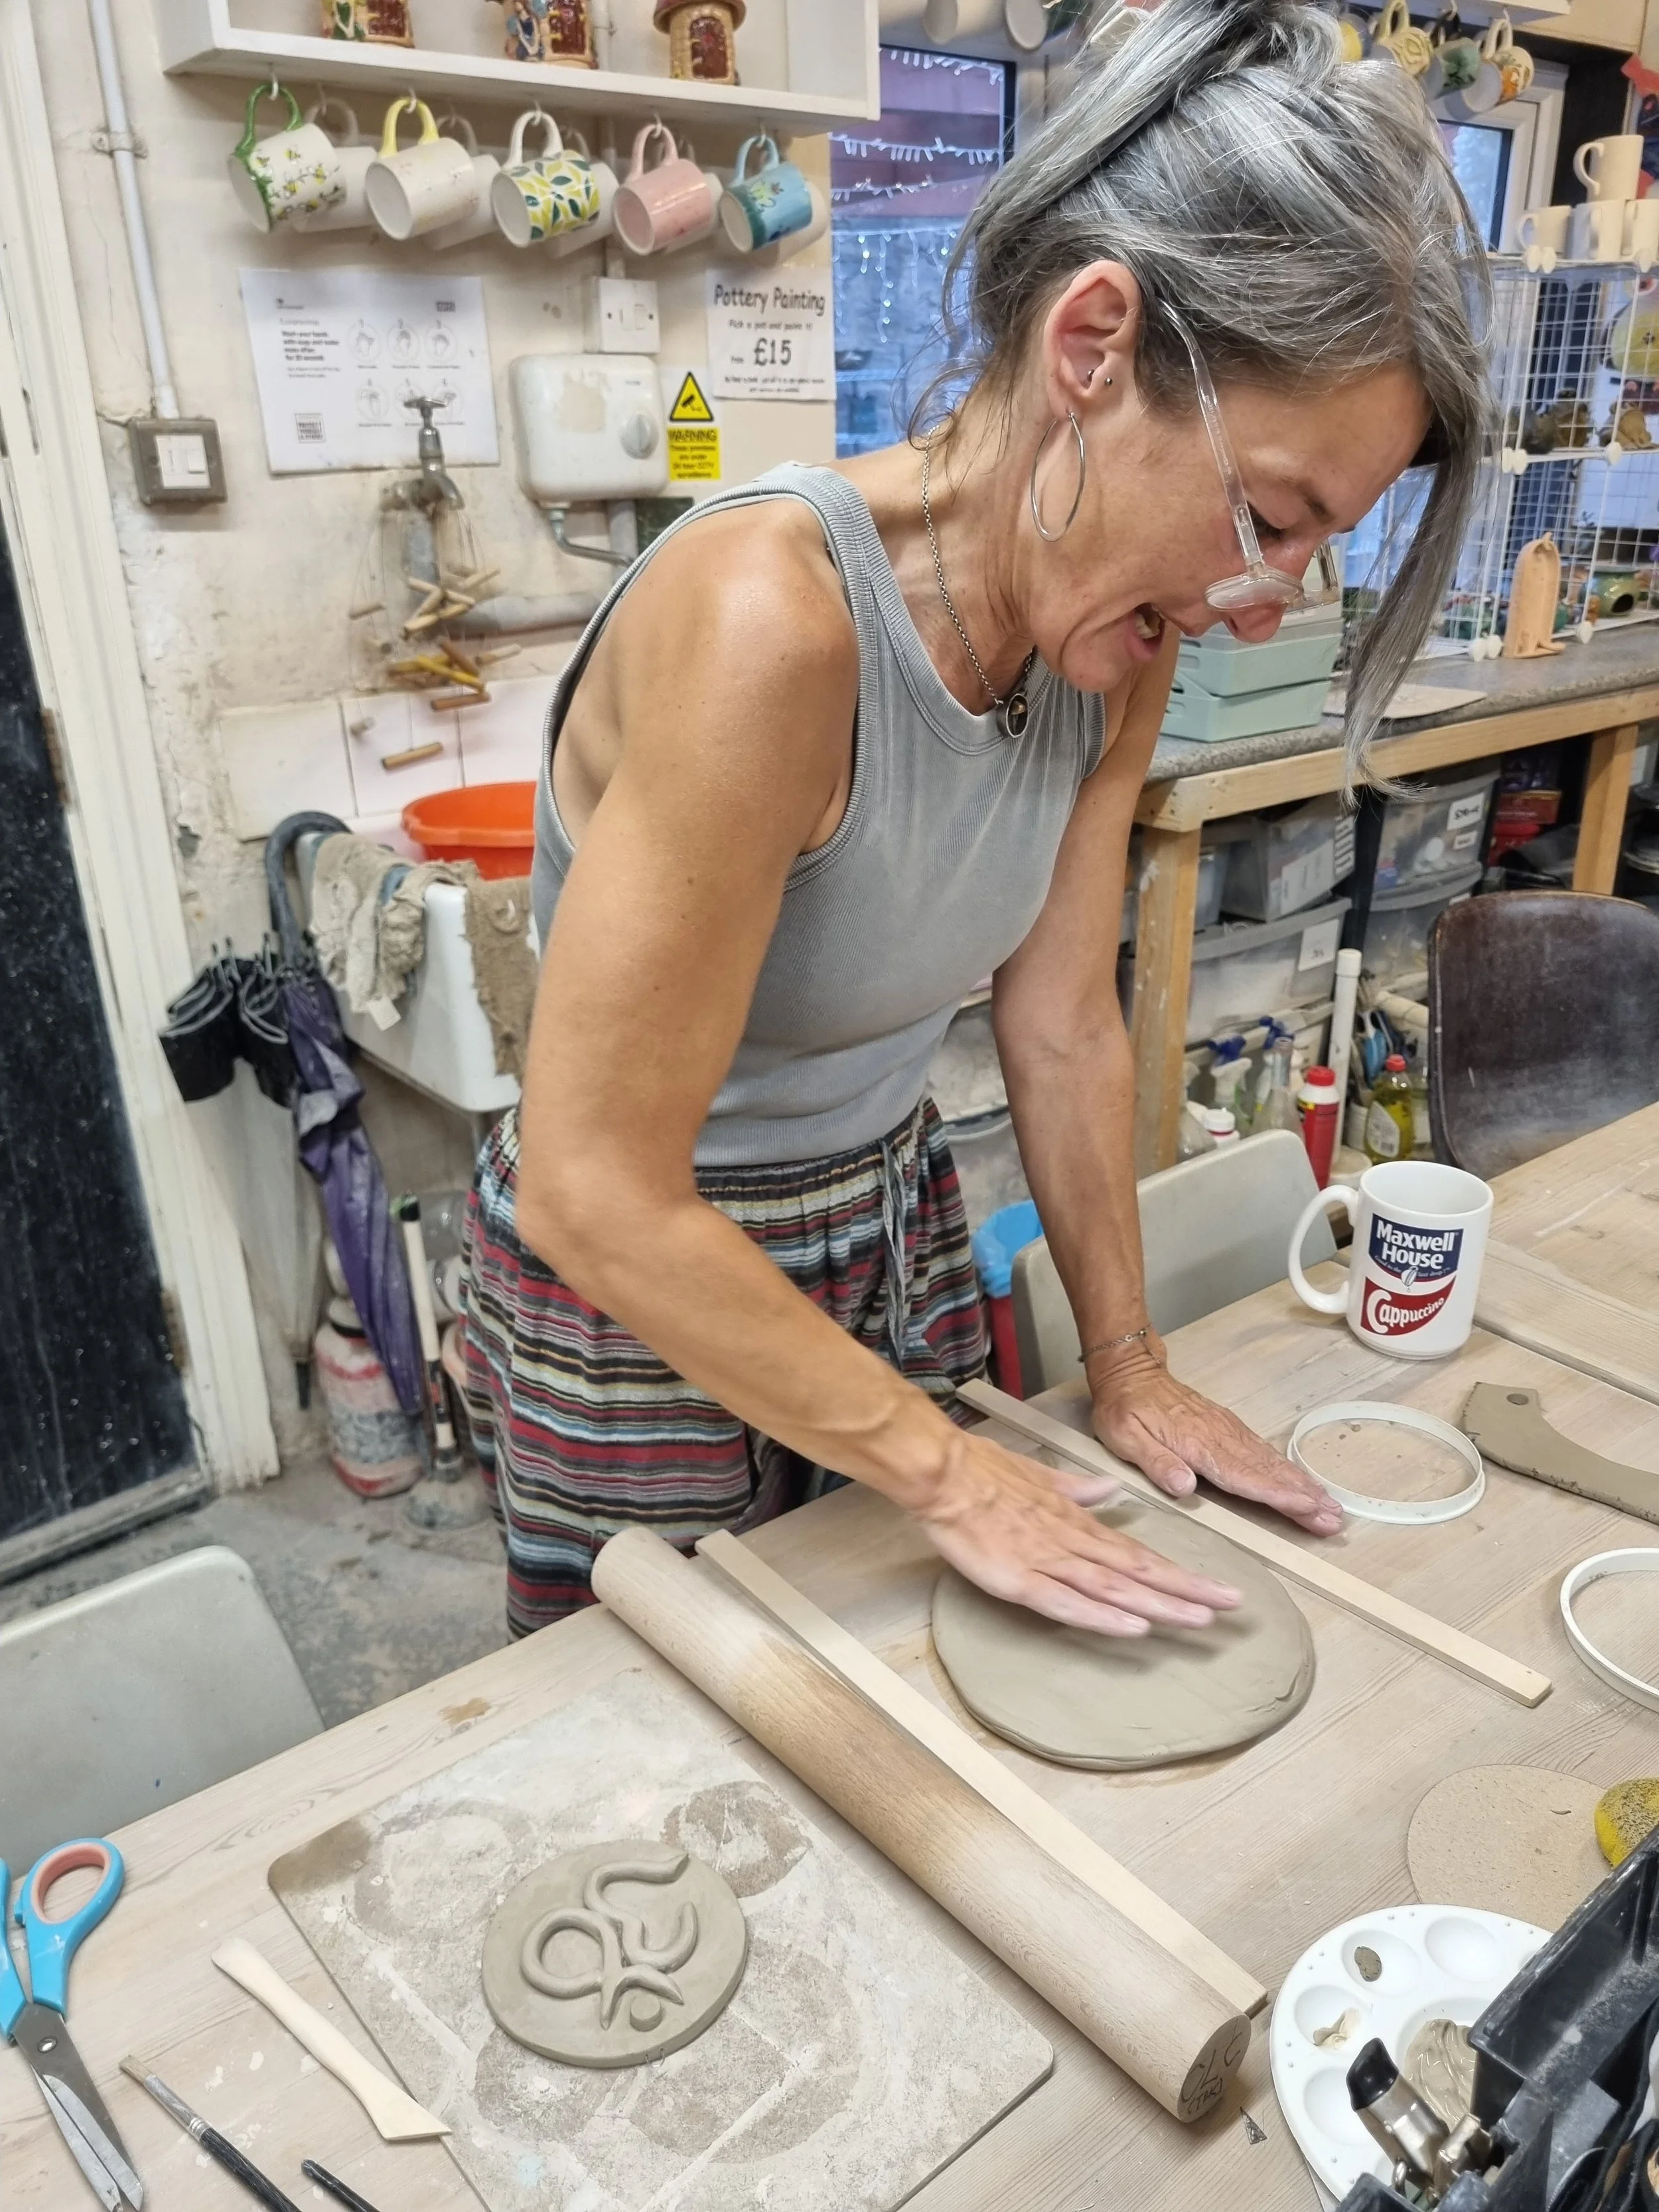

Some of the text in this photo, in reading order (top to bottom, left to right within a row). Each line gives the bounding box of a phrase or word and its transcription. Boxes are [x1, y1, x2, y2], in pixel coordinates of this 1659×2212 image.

[713, 284, 826, 317] Pottery Painting
[754, 337, 792, 366] £15
[667, 429, 717, 441] WARNING
[1376, 1219, 1455, 1252] Maxwell
[1382, 1243, 1445, 1269] House
[1366, 1289, 1445, 1334] Cappuccino
